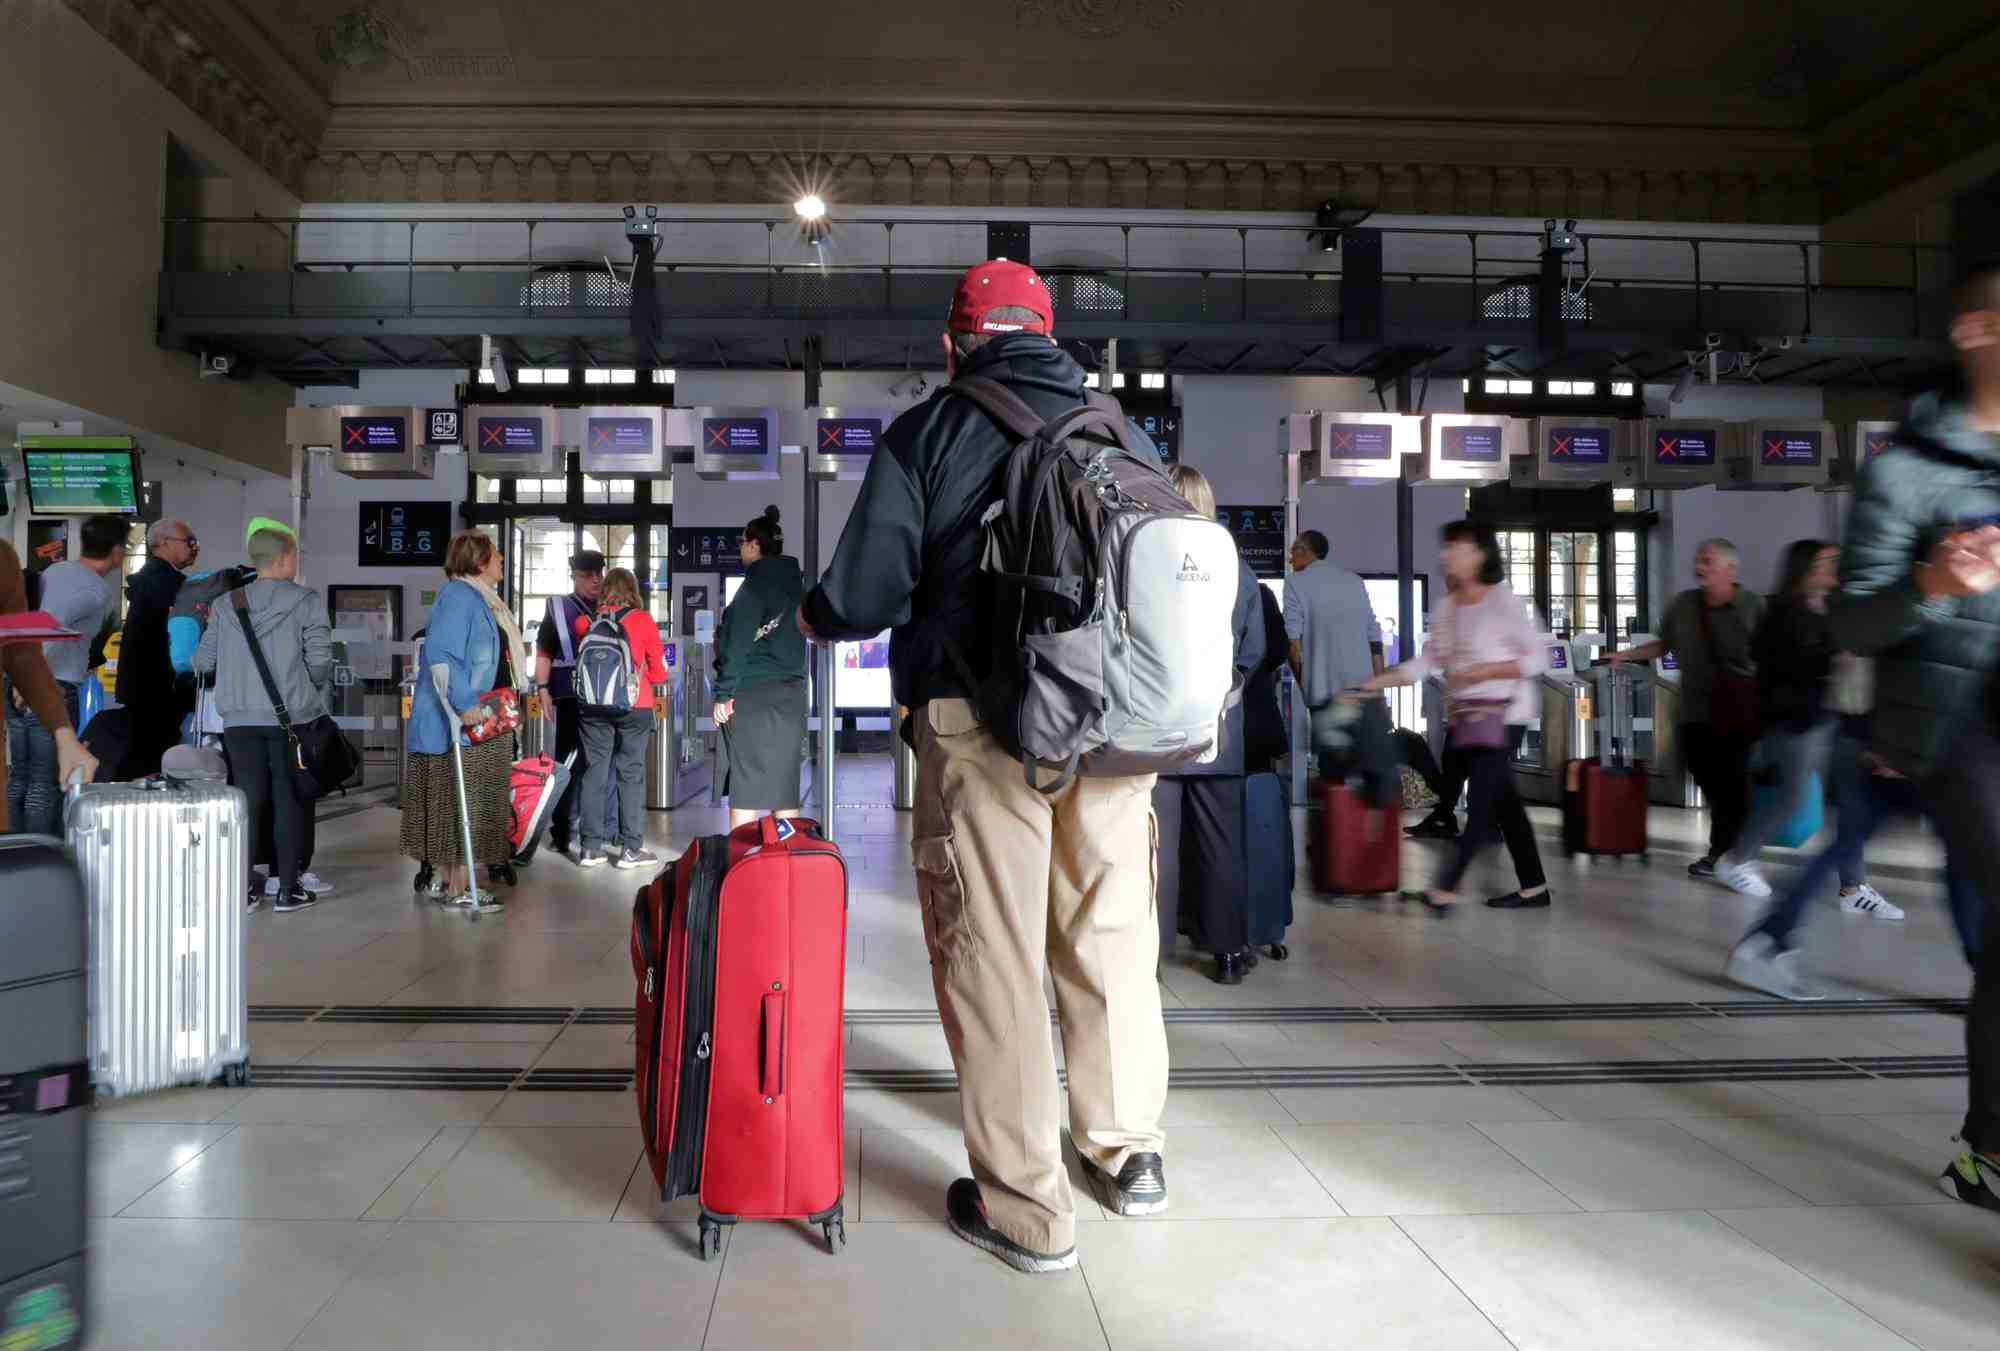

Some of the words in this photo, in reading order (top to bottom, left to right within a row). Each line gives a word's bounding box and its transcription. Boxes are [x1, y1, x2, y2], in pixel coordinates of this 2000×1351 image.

[1242, 517, 1255, 530] A
[391, 537, 403, 552] B
[418, 537, 431, 552] G
[1239, 545, 1283, 557] Ascenseur
[531, 703, 538, 713] 2
